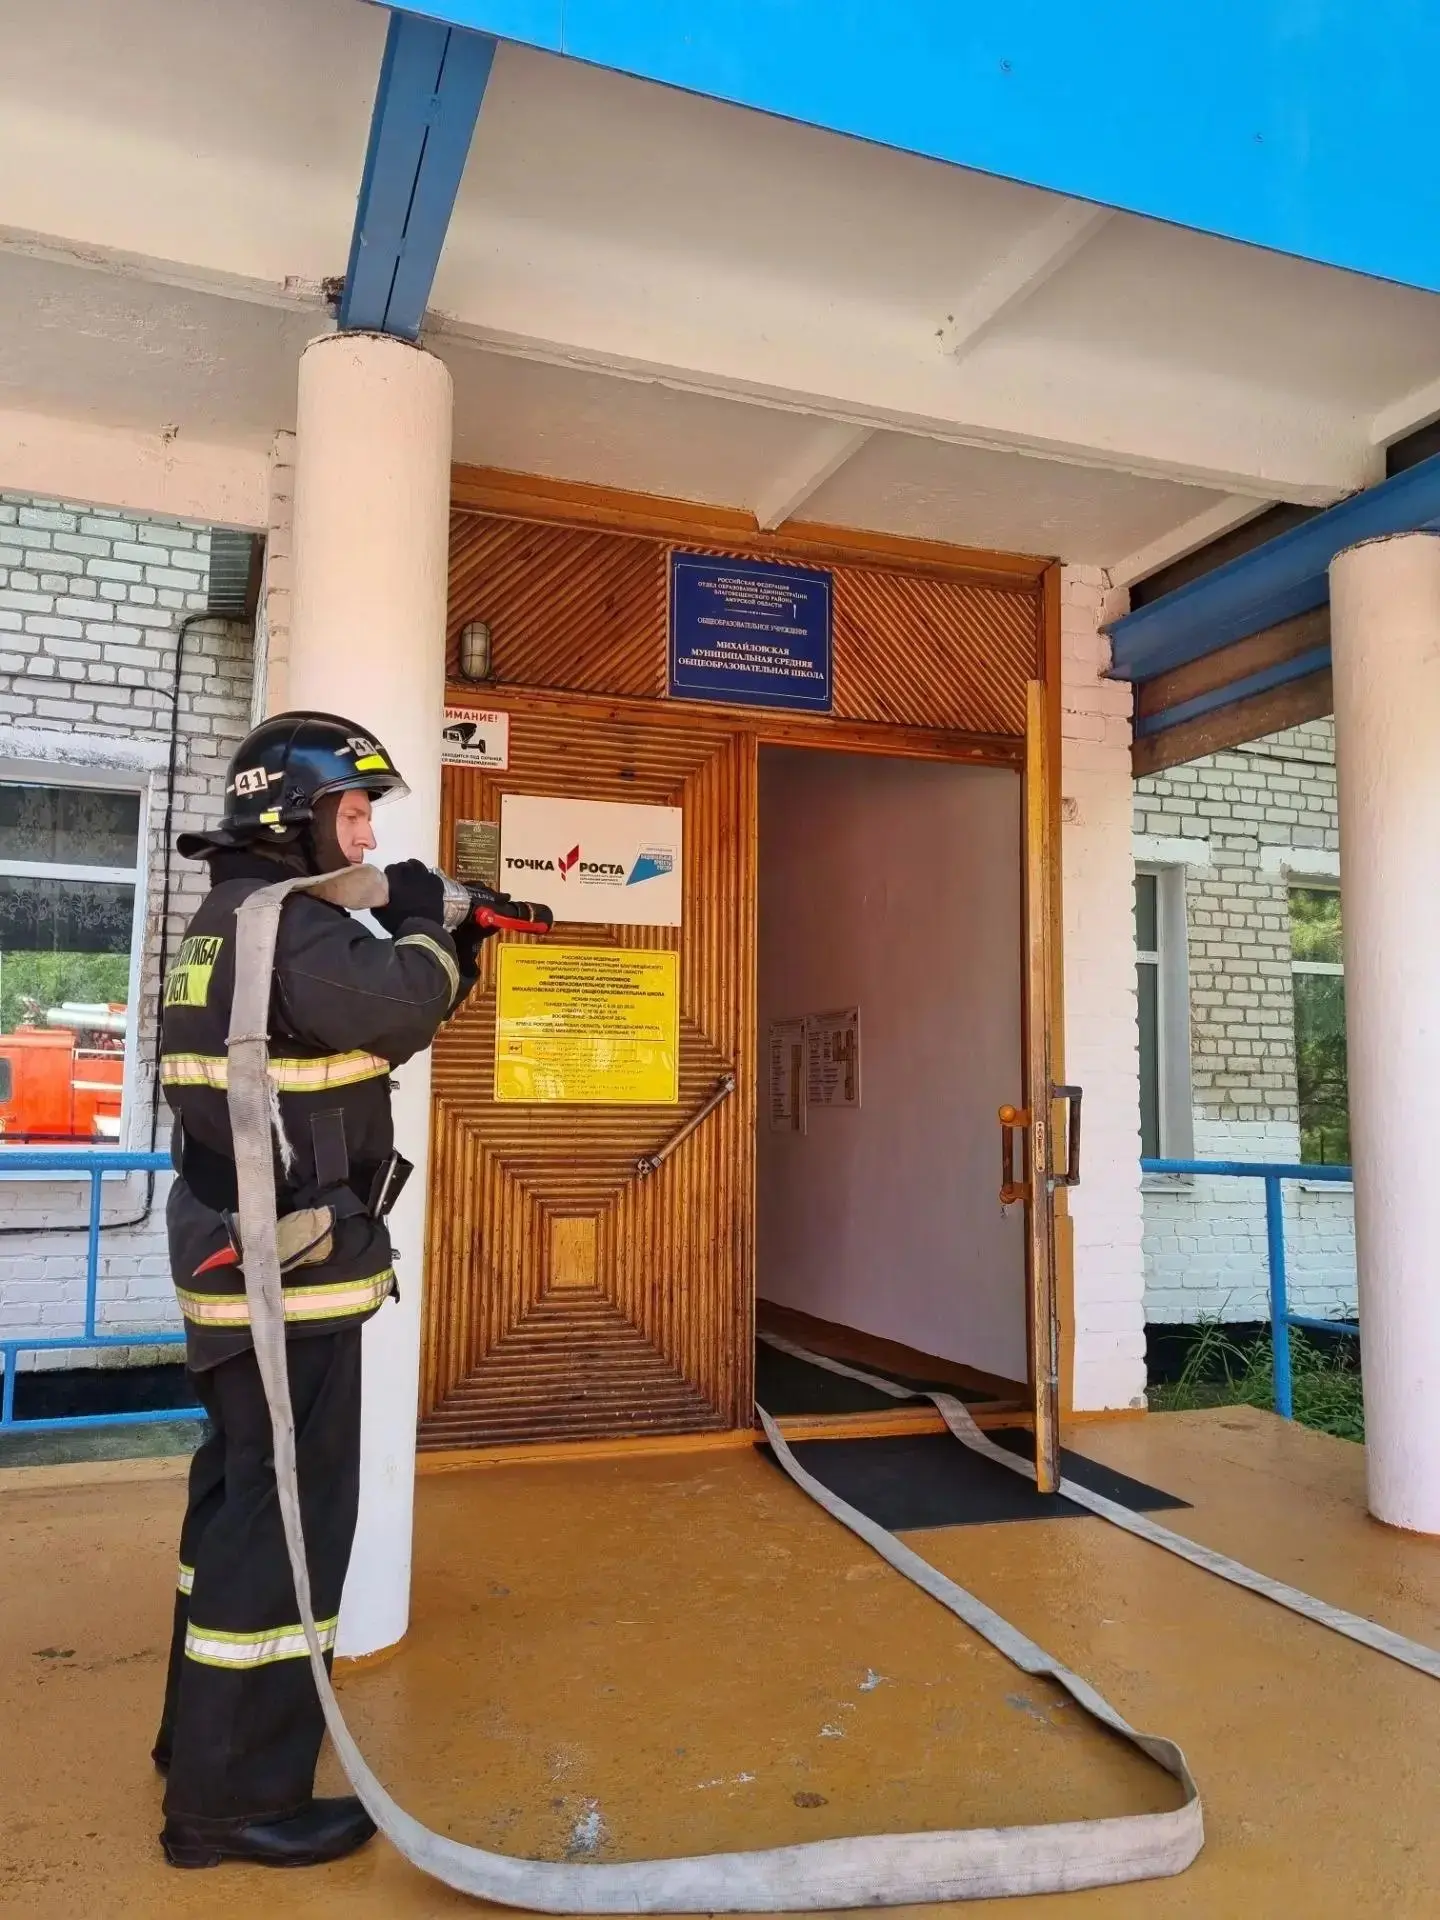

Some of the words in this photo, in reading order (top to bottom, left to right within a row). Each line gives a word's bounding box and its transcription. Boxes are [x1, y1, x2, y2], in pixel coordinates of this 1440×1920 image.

[718, 578, 756, 586] РОССИЙСКАЯ
[757, 581, 790, 590] ФЕДЕРАЦИЯ
[771, 595, 792, 603] РАЙОНА
[716, 640, 789, 655] МИХАЙЛОВСКАЯ
[691, 648, 772, 664] МУНИЦИПАЛЬНАЯ
[774, 657, 813, 668] СРЕДНЯЯ
[678, 657, 789, 675] ОБЩЕОБРАЗОВАТЕЛЬНАЯ
[791, 670, 824, 680] ШКОЛА
[443, 710, 498, 722] ИМАНИЕ!
[355, 740, 374, 752] 41
[240, 772, 266, 790] 41
[505, 858, 554, 871] ТОЧКА
[579, 862, 624, 875] РОСТА
